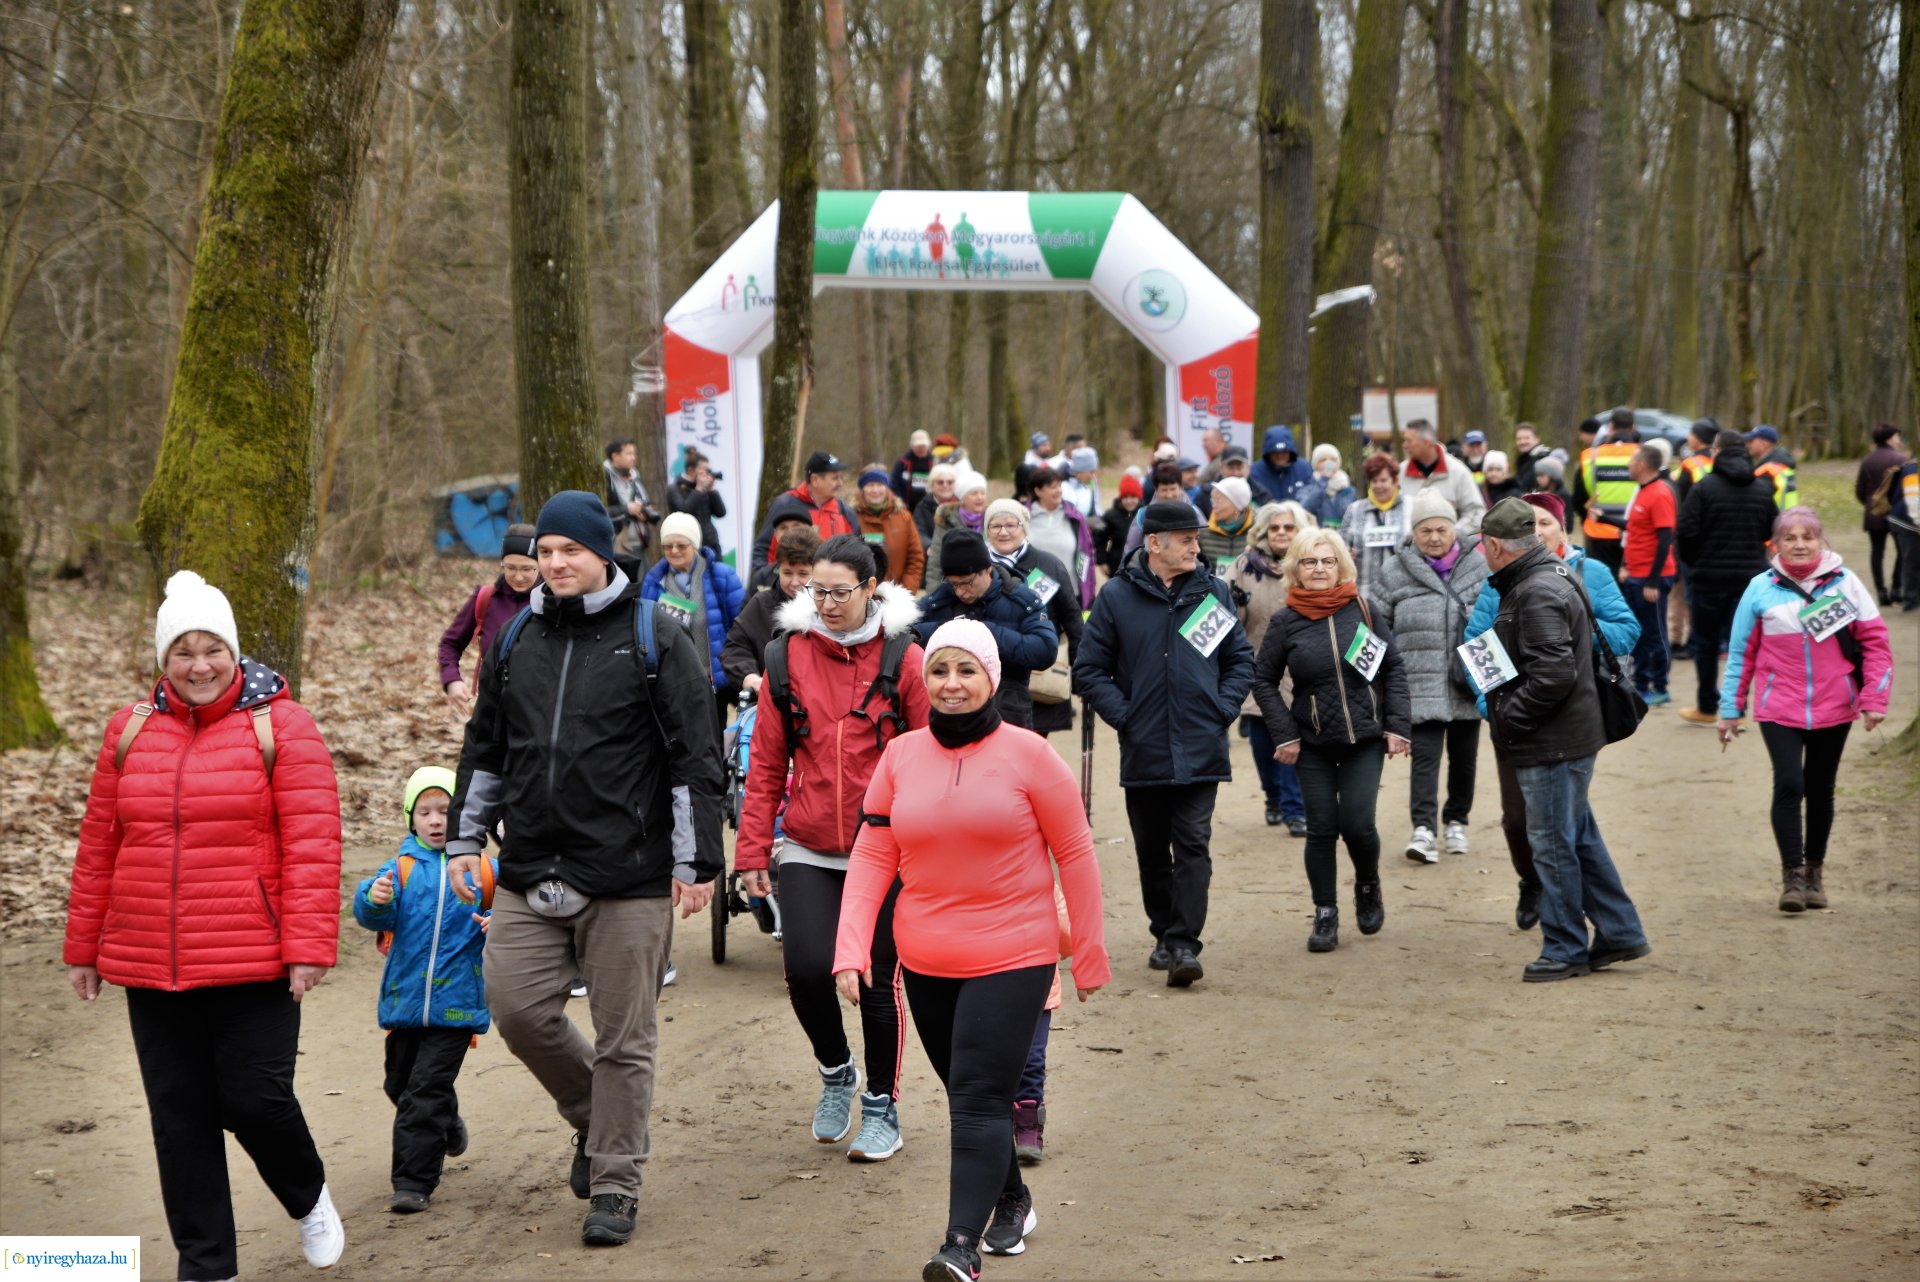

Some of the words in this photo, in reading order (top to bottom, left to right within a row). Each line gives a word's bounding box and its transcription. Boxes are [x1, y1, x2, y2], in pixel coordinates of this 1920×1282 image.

[951, 229, 1084, 248] Magyarországért
[965, 257, 1041, 273] Egyesület
[680, 399, 696, 433] Fitt
[696, 384, 722, 447] Ápoló
[1190, 397, 1208, 431] Fitt
[1209, 366, 1232, 445] ondozó
[1190, 610, 1226, 648] 082
[1808, 602, 1847, 633] 038
[1355, 637, 1378, 671] 081
[1467, 638, 1502, 680] 234
